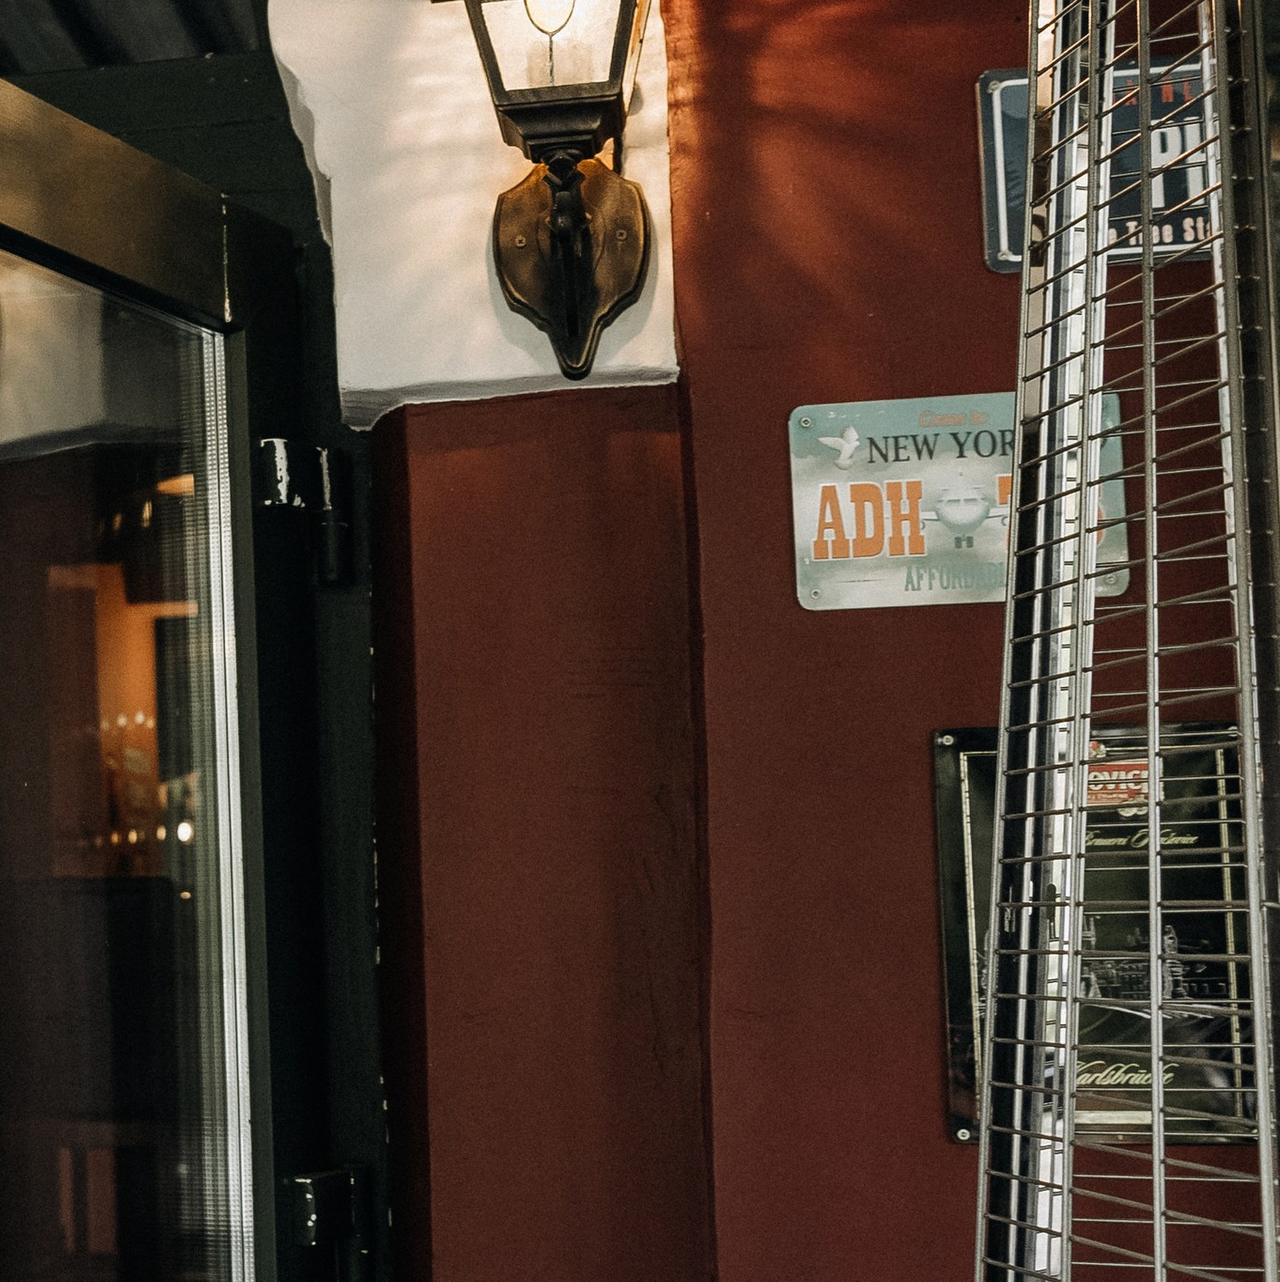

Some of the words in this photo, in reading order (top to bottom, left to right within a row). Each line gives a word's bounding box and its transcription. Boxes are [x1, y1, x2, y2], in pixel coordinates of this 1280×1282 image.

[867, 433, 940, 464] NEW
[948, 429, 1015, 459] YOR
[812, 479, 927, 561] ADH
